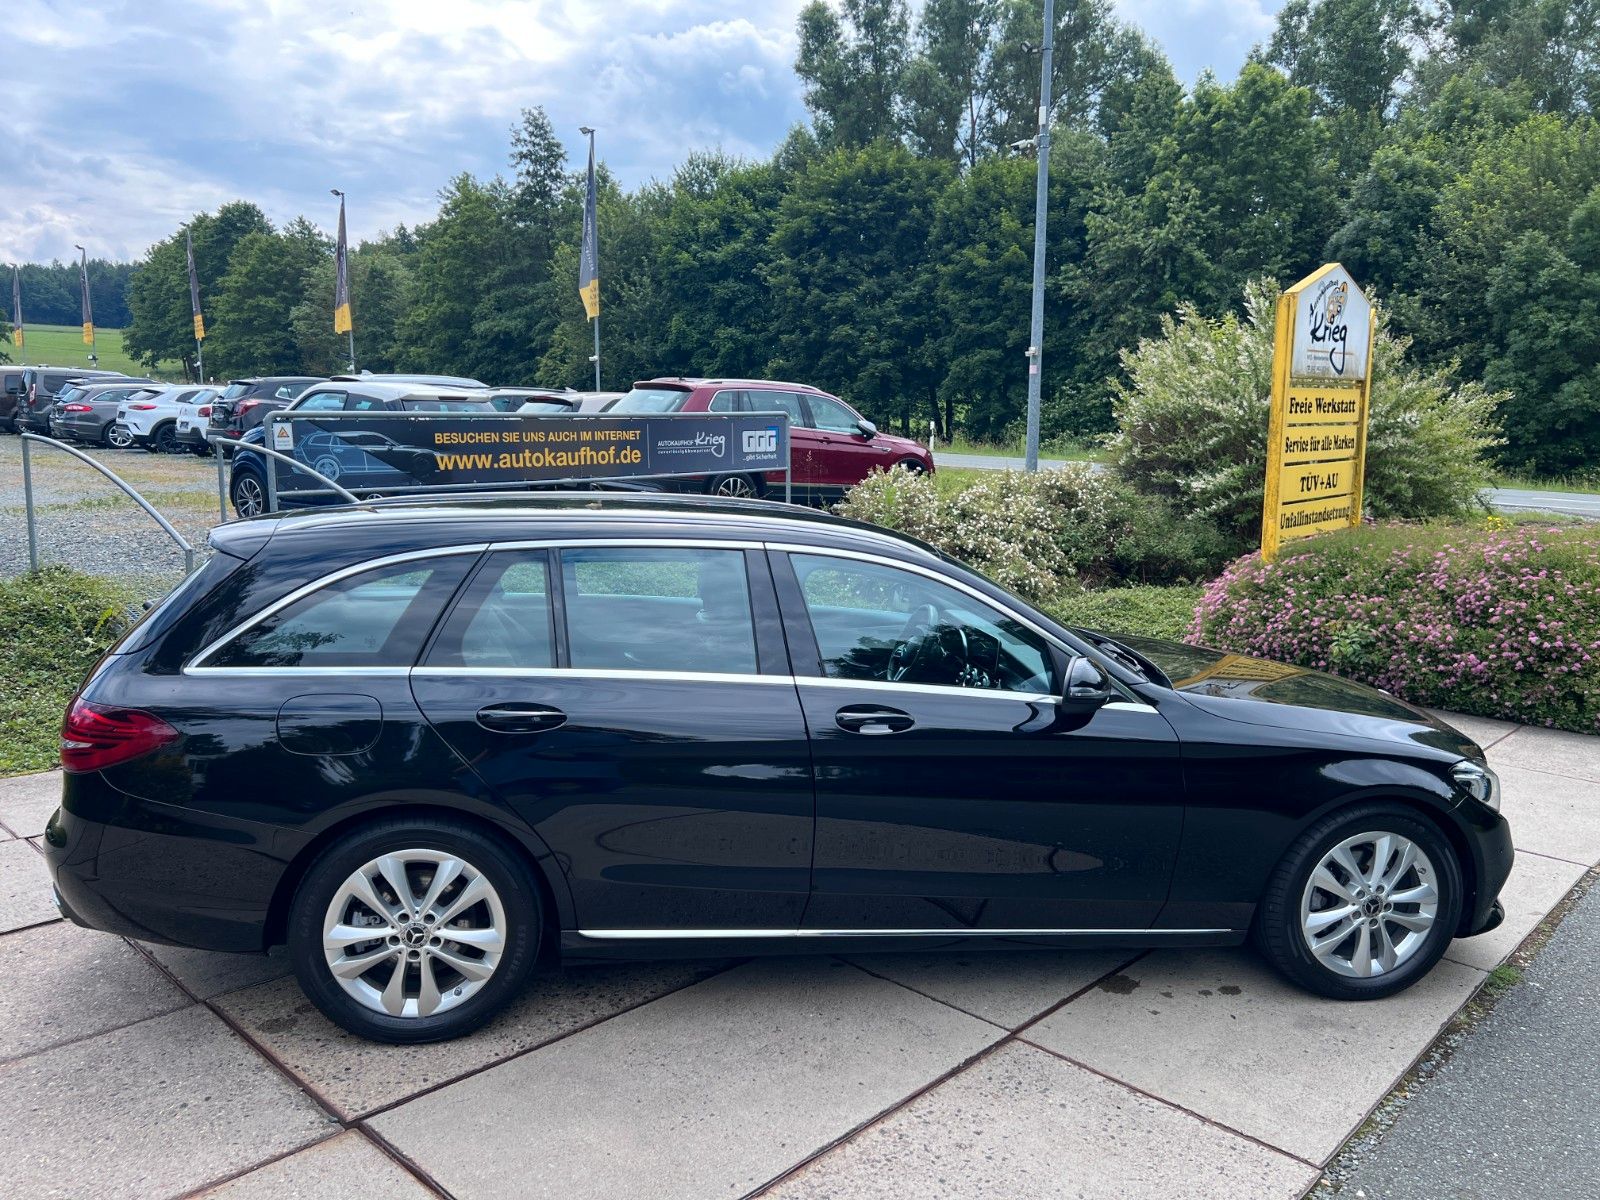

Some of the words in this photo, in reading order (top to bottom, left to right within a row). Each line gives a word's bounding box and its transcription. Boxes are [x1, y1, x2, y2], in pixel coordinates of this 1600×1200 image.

[1310, 311, 1347, 375] Krieg
[1289, 397, 1312, 414] Freie
[1315, 397, 1356, 413] Werkstatt
[434, 432, 499, 444] BESUCHEN
[502, 432, 520, 443] SIE
[522, 431, 546, 442] UNS
[548, 431, 577, 442] AUCH
[580, 431, 592, 441] IM
[594, 430, 641, 441] INTERNET
[694, 432, 726, 457] Krieg
[1285, 436, 1308, 453] Service
[1310, 435, 1320, 452] für
[1321, 435, 1332, 451] alle
[1333, 434, 1355, 450] Marken
[436, 446, 642, 471] www.autokaufhof.de
[1280, 505, 1351, 530] Unfallinstandsetzung
